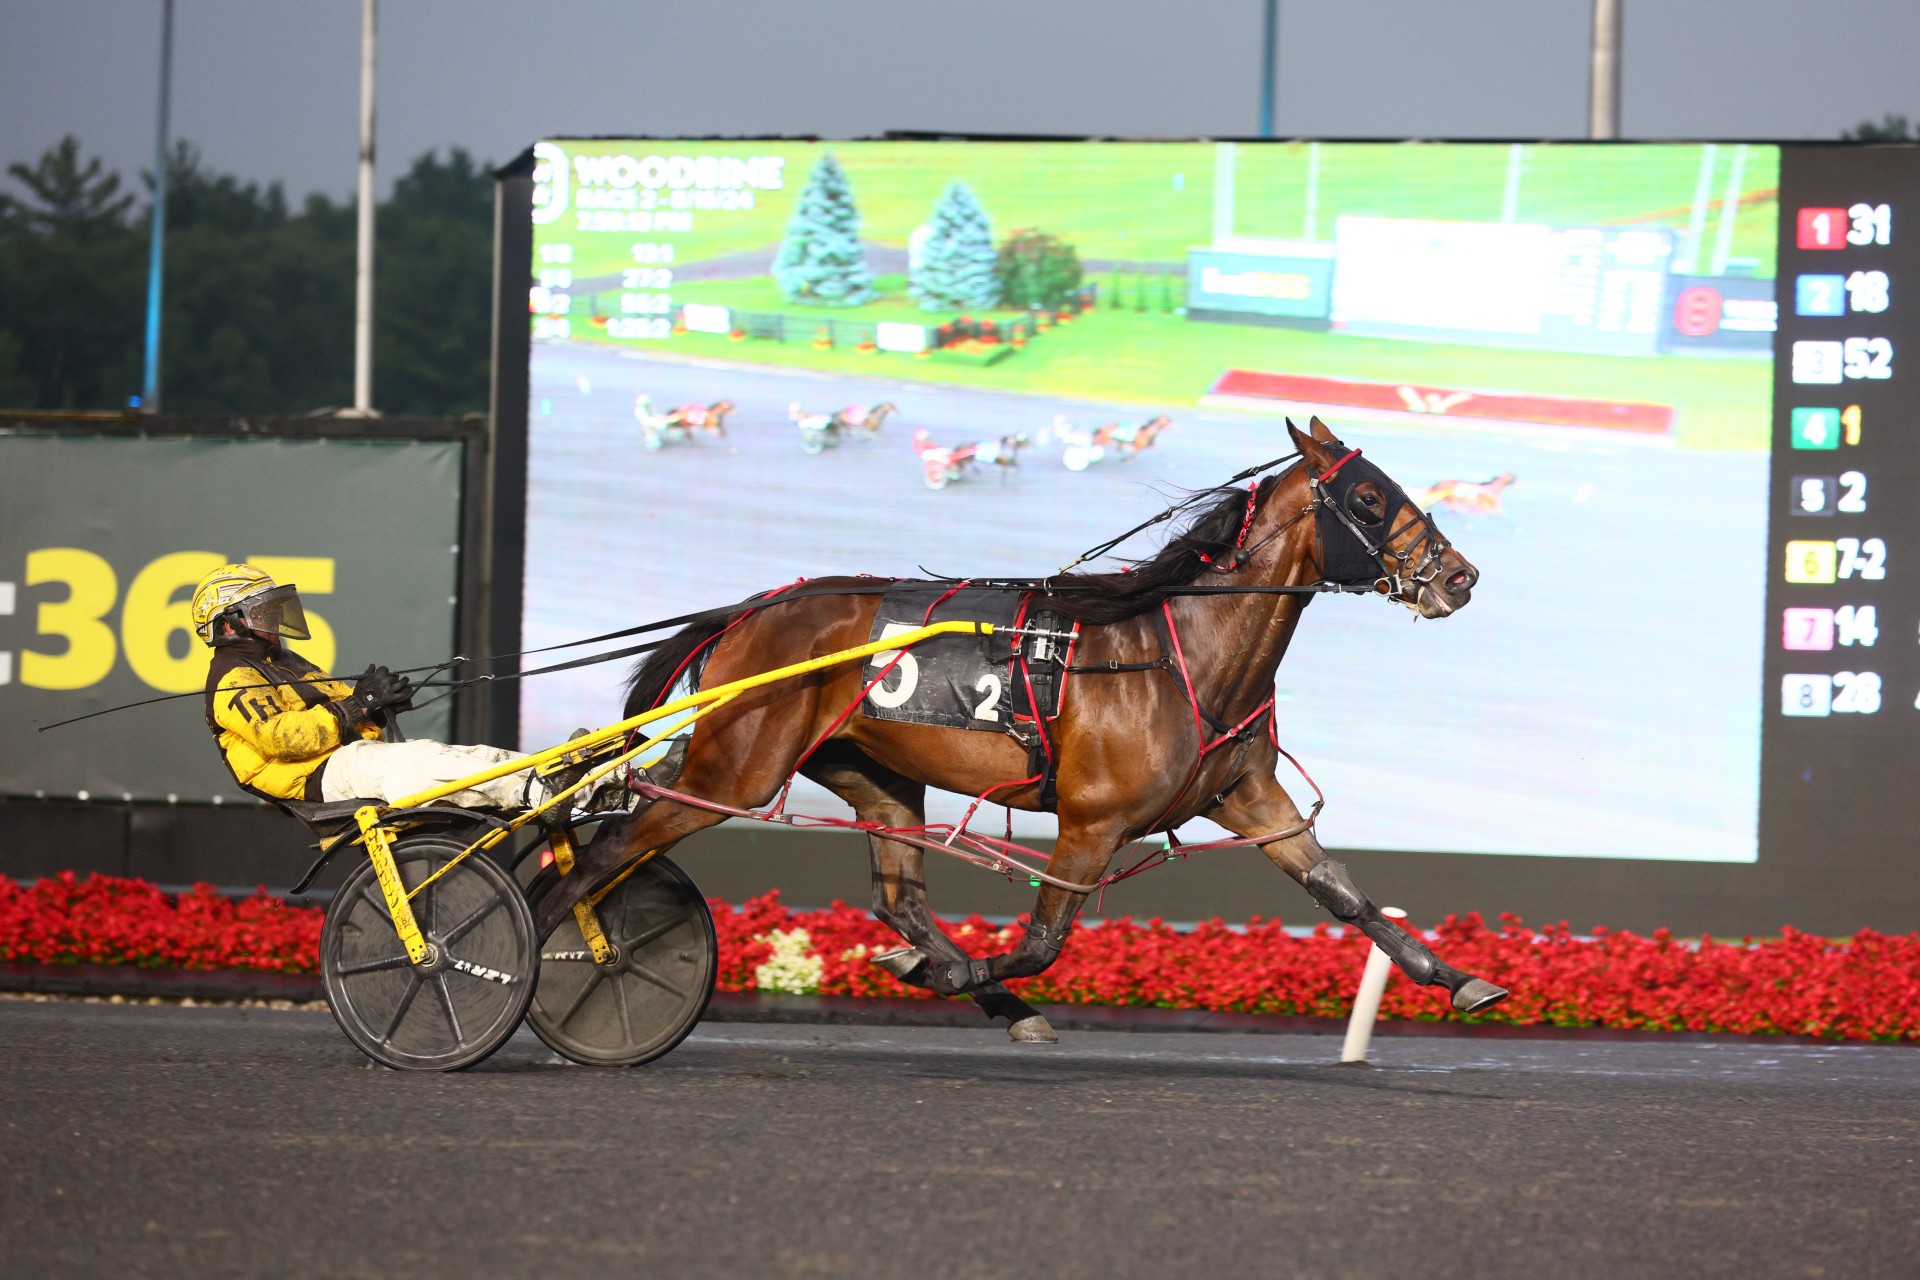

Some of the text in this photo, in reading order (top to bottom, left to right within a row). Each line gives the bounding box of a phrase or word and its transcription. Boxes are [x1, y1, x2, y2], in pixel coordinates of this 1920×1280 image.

[574, 155, 785, 189] WOODBINE
[575, 188, 638, 209] RACE
[640, 189, 658, 209] 2
[653, 211, 694, 232] PM
[1812, 203, 1891, 245] 1 31
[1810, 271, 1890, 314] 2 18
[1812, 337, 1893, 379] 3 52
[1803, 405, 1861, 445] 4 1
[1800, 470, 1867, 513] 5 2
[1804, 538, 1886, 580] 6 7-2
[0, 547, 336, 694] 365
[1803, 617, 1817, 642] 7
[1834, 605, 1878, 646] 14
[867, 624, 918, 708] 5
[975, 674, 1001, 721] 2
[1800, 684, 1813, 707] 8
[1831, 671, 1882, 714] 28
